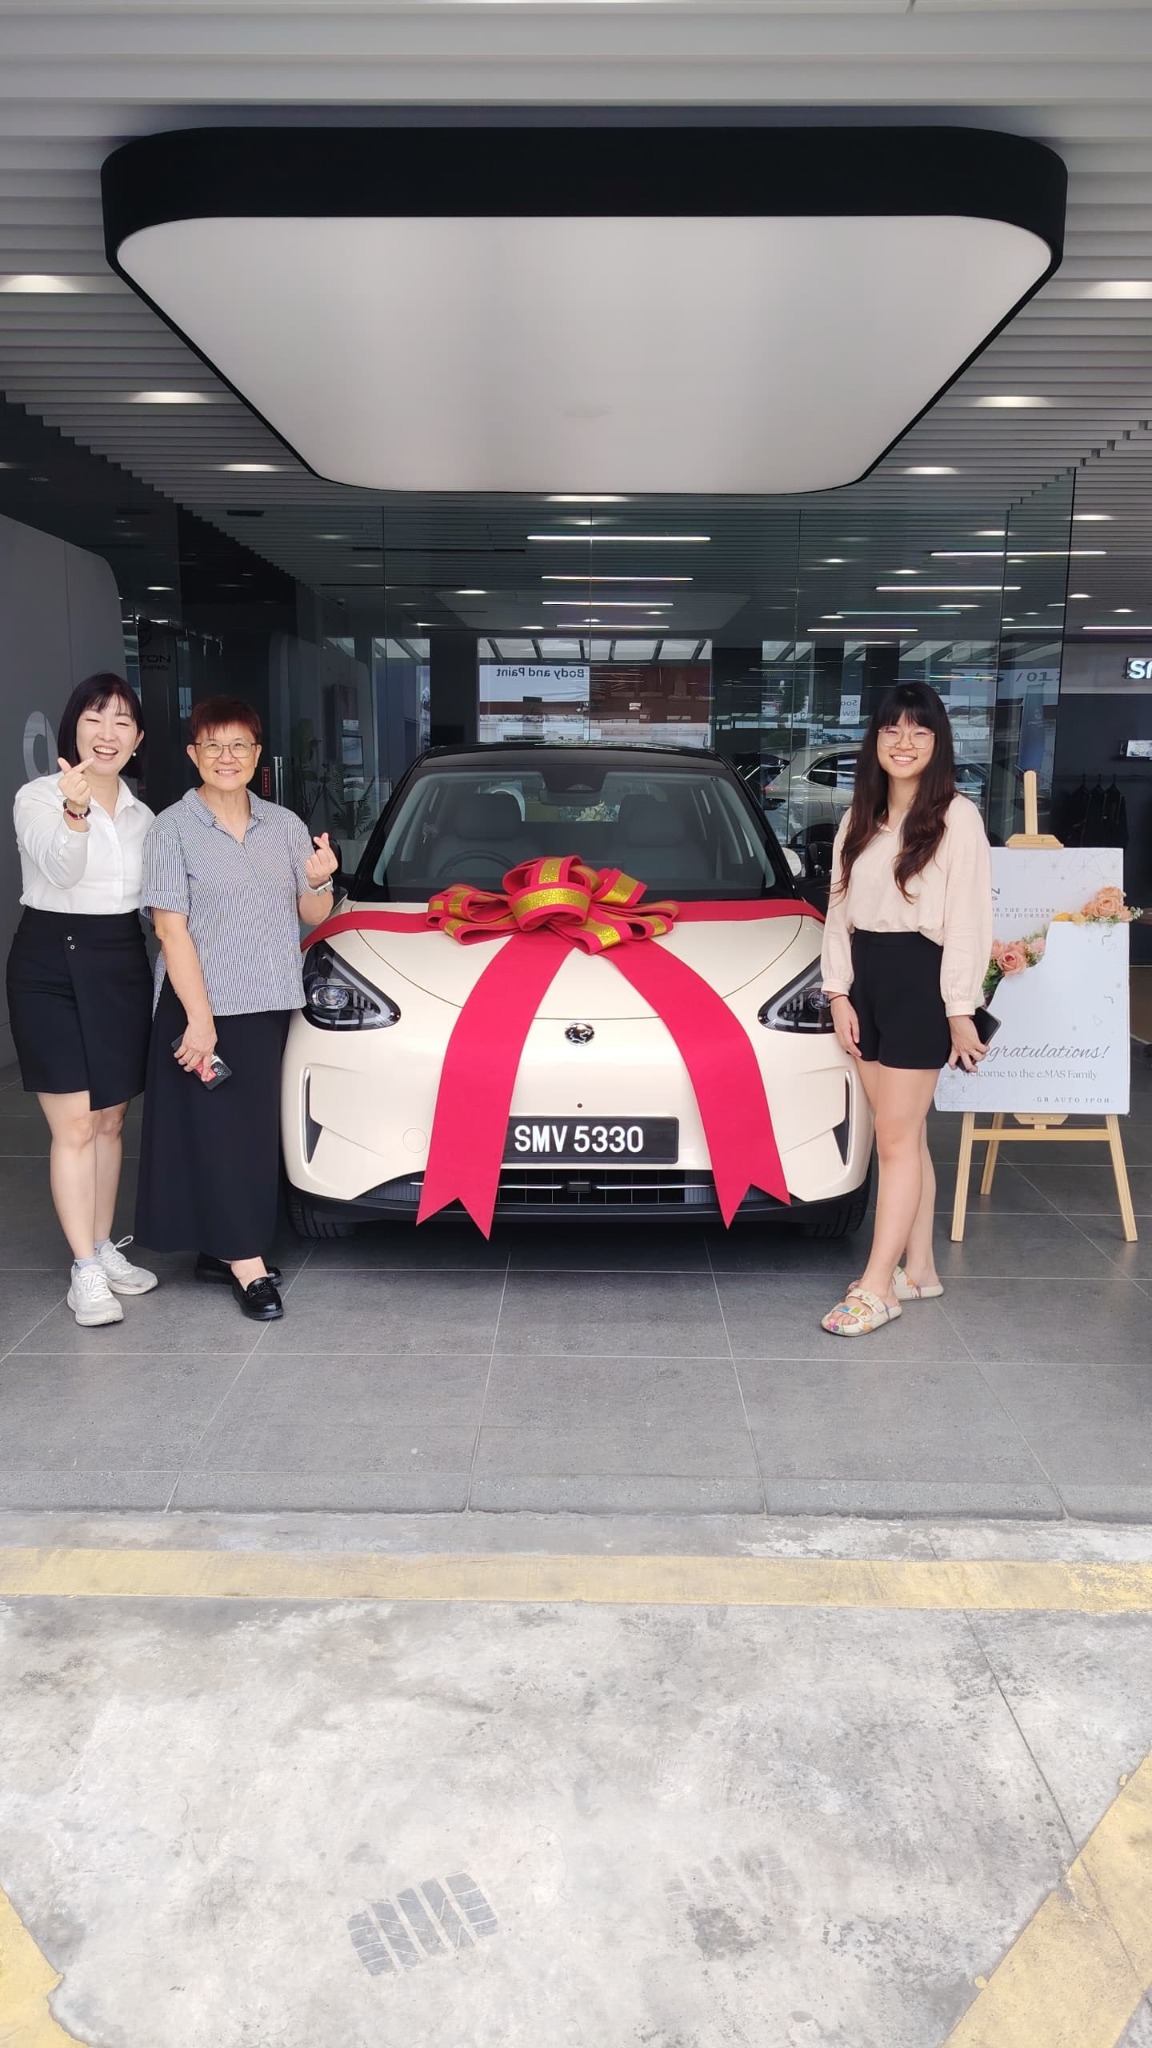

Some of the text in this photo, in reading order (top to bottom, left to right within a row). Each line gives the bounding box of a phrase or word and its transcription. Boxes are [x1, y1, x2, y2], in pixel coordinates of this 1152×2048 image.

[986, 1043, 1111, 1062] gratulations!
[1007, 1070, 1018, 1078] to
[1019, 1069, 1036, 1078] the
[1067, 1069, 1097, 1081] Family
[514, 1124, 644, 1153] SMV 5330
